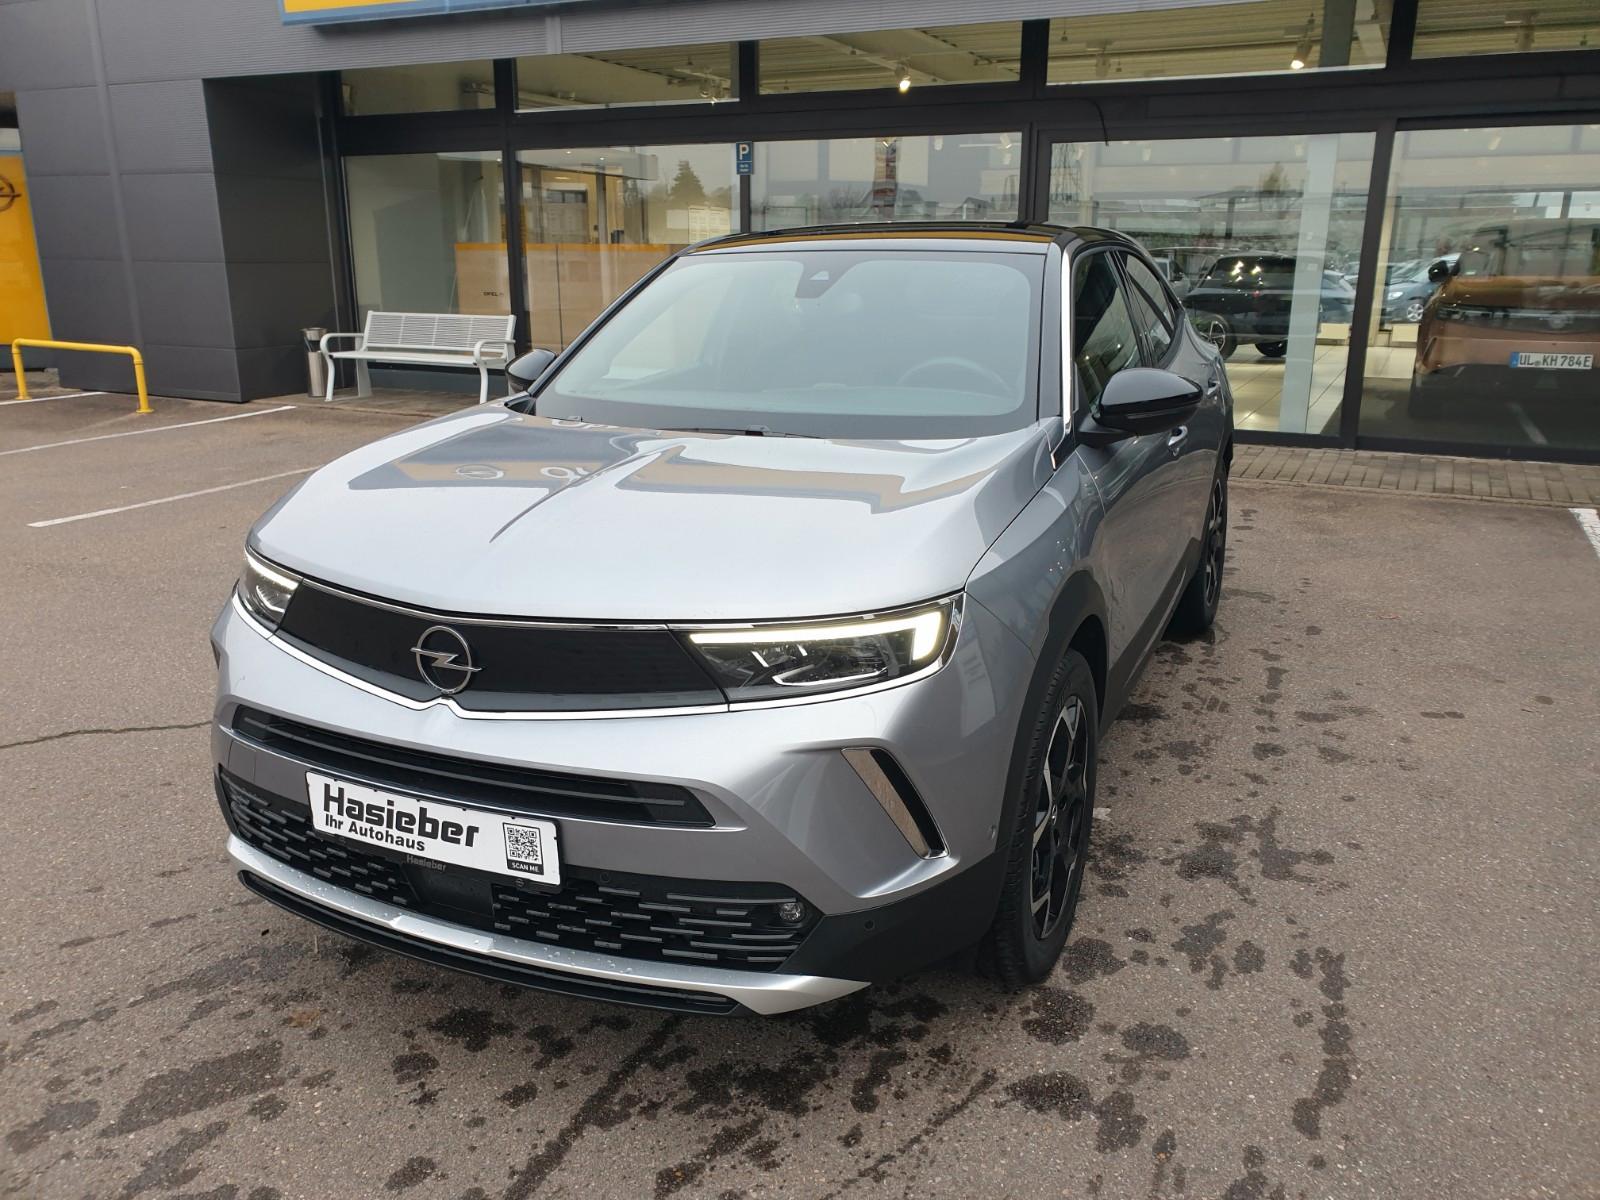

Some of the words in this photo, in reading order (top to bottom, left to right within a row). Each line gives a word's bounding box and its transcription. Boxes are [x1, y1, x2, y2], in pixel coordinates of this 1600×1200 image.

[739, 144, 749, 160] P
[1519, 354, 1533, 366] UL
[1542, 355, 1558, 367] KH
[1560, 355, 1591, 368] 784E
[323, 783, 480, 848] Hasieber
[325, 812, 344, 830] Ihr
[348, 820, 426, 852] Autohaus
[406, 853, 447, 871] Hasieber
[511, 861, 529, 871] SCAN
